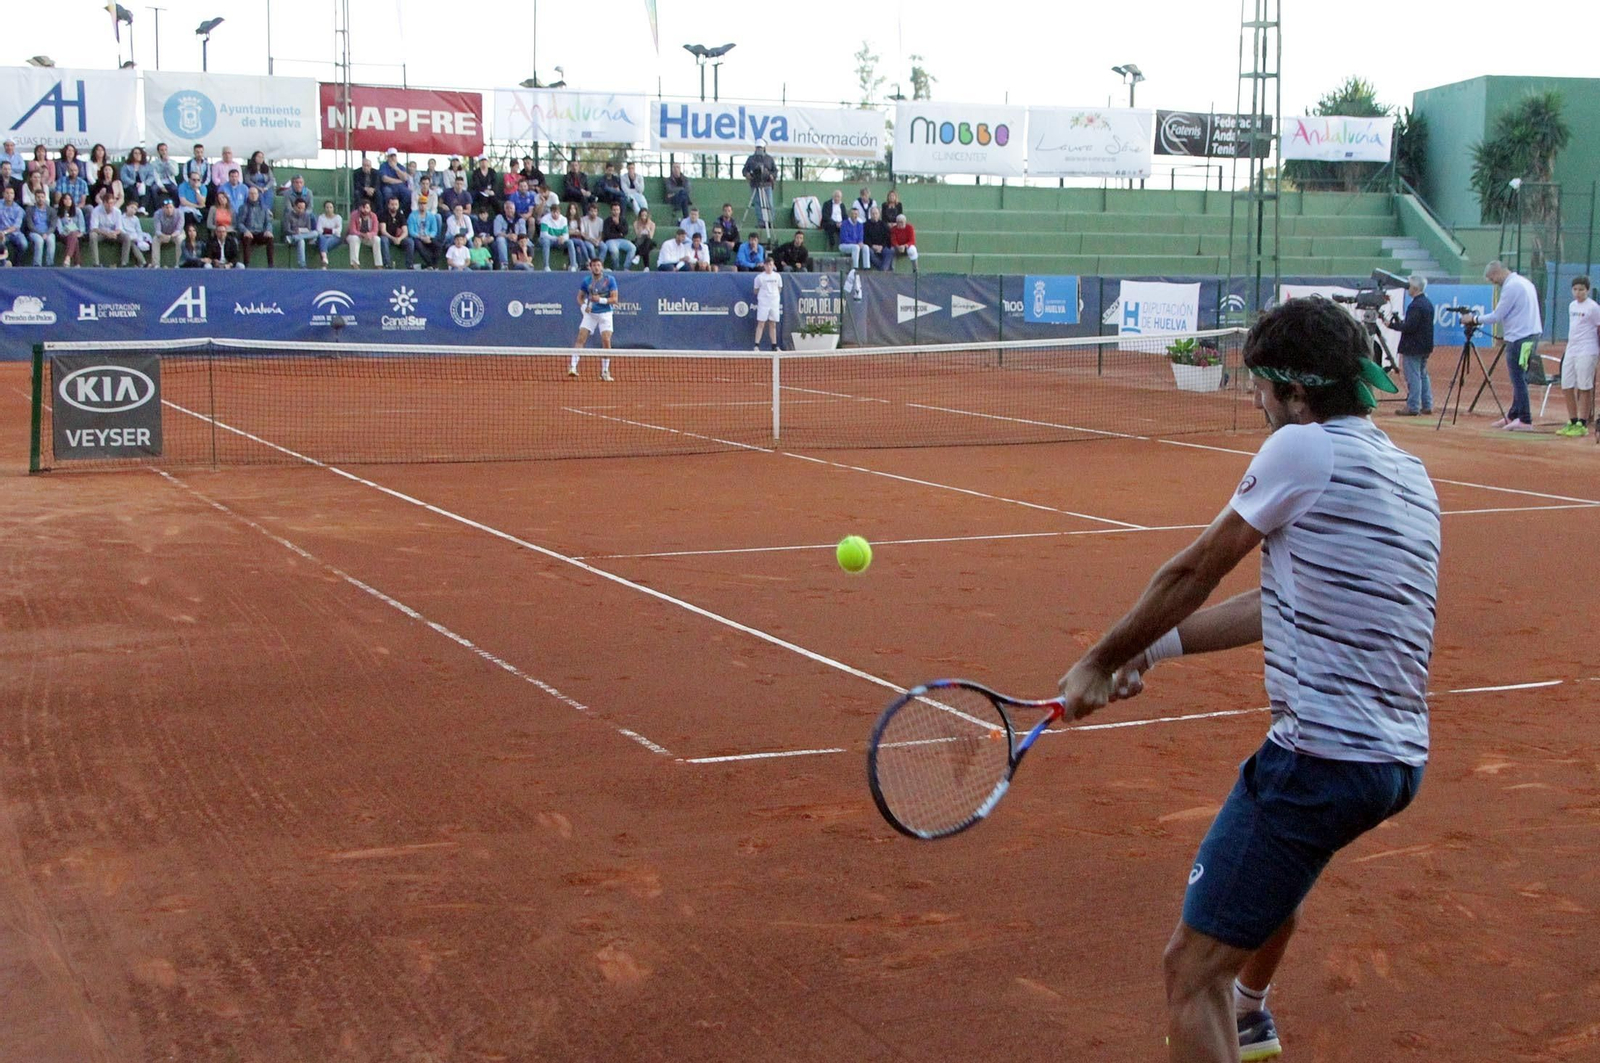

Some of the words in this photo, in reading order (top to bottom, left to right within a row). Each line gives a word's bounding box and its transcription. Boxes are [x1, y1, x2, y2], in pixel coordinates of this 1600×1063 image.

[219, 103, 301, 117] Ayuntamiento
[241, 116, 257, 127] de
[259, 116, 302, 128] Huelva
[327, 105, 476, 136] MAPFRE
[659, 103, 789, 142] Huelva
[792, 127, 878, 148] Información
[12, 136, 38, 145] GUAS
[40, 137, 53, 146] DE
[1291, 120, 1384, 146] Andalucía
[98, 303, 140, 311] DIPUTACIÓN
[658, 297, 699, 311] Huelva
[798, 297, 818, 314] COPA
[819, 298, 832, 314] DEL
[1142, 300, 1193, 317] DIPUTACIÓN
[109, 310, 138, 318] HUELVA
[1141, 315, 1152, 328] DE
[1153, 316, 1187, 331] HUELVA
[76, 376, 140, 402] KIA
[66, 428, 151, 448] VEYSER
